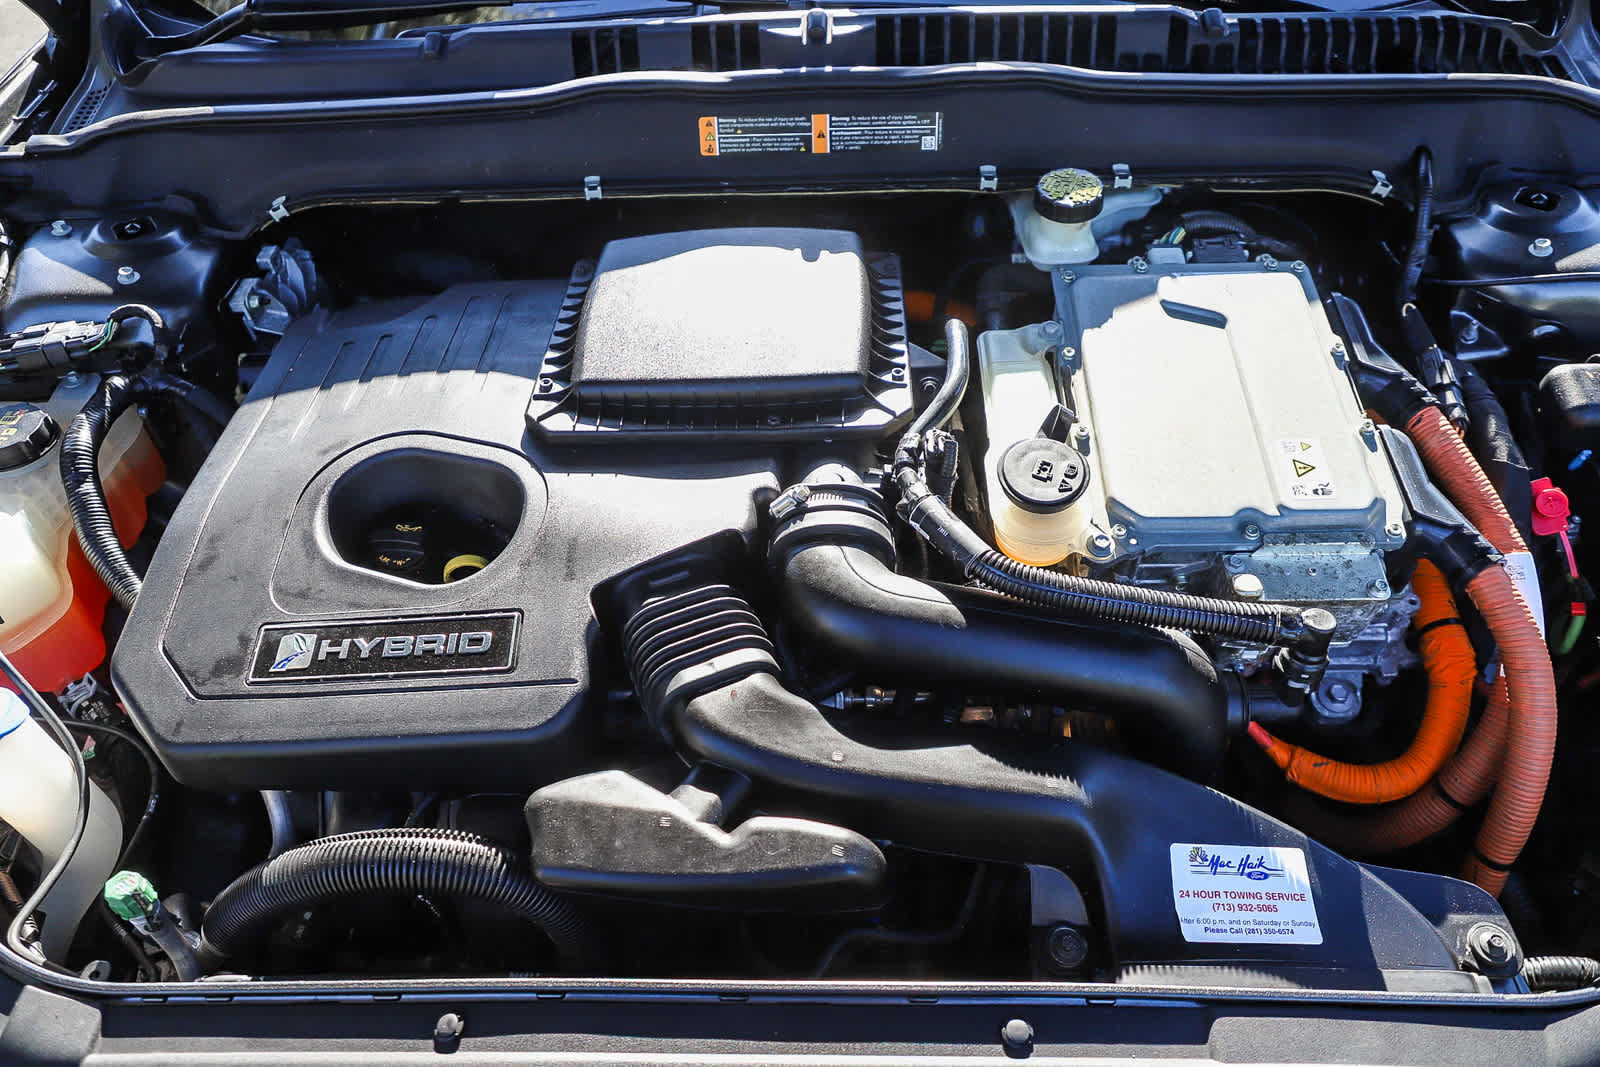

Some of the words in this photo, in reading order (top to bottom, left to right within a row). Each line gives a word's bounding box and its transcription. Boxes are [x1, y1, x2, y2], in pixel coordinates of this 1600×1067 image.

[318, 631, 493, 661] HYBRID
[1207, 854, 1236, 876] Mac
[1237, 853, 1270, 876] Haik
[1179, 889, 1191, 899] 24
[1192, 890, 1222, 899] HOUR
[1223, 890, 1263, 900] TOWING
[1265, 892, 1308, 902] SERVICE
[1212, 902, 1236, 913] (713)
[1237, 903, 1279, 913] 932-5065
[1196, 917, 1212, 925] 6:00
[1252, 918, 1282, 928] Saturday
[1291, 919, 1316, 929] Sunday
[1204, 926, 1228, 934] Please
[1229, 927, 1243, 935] Call
